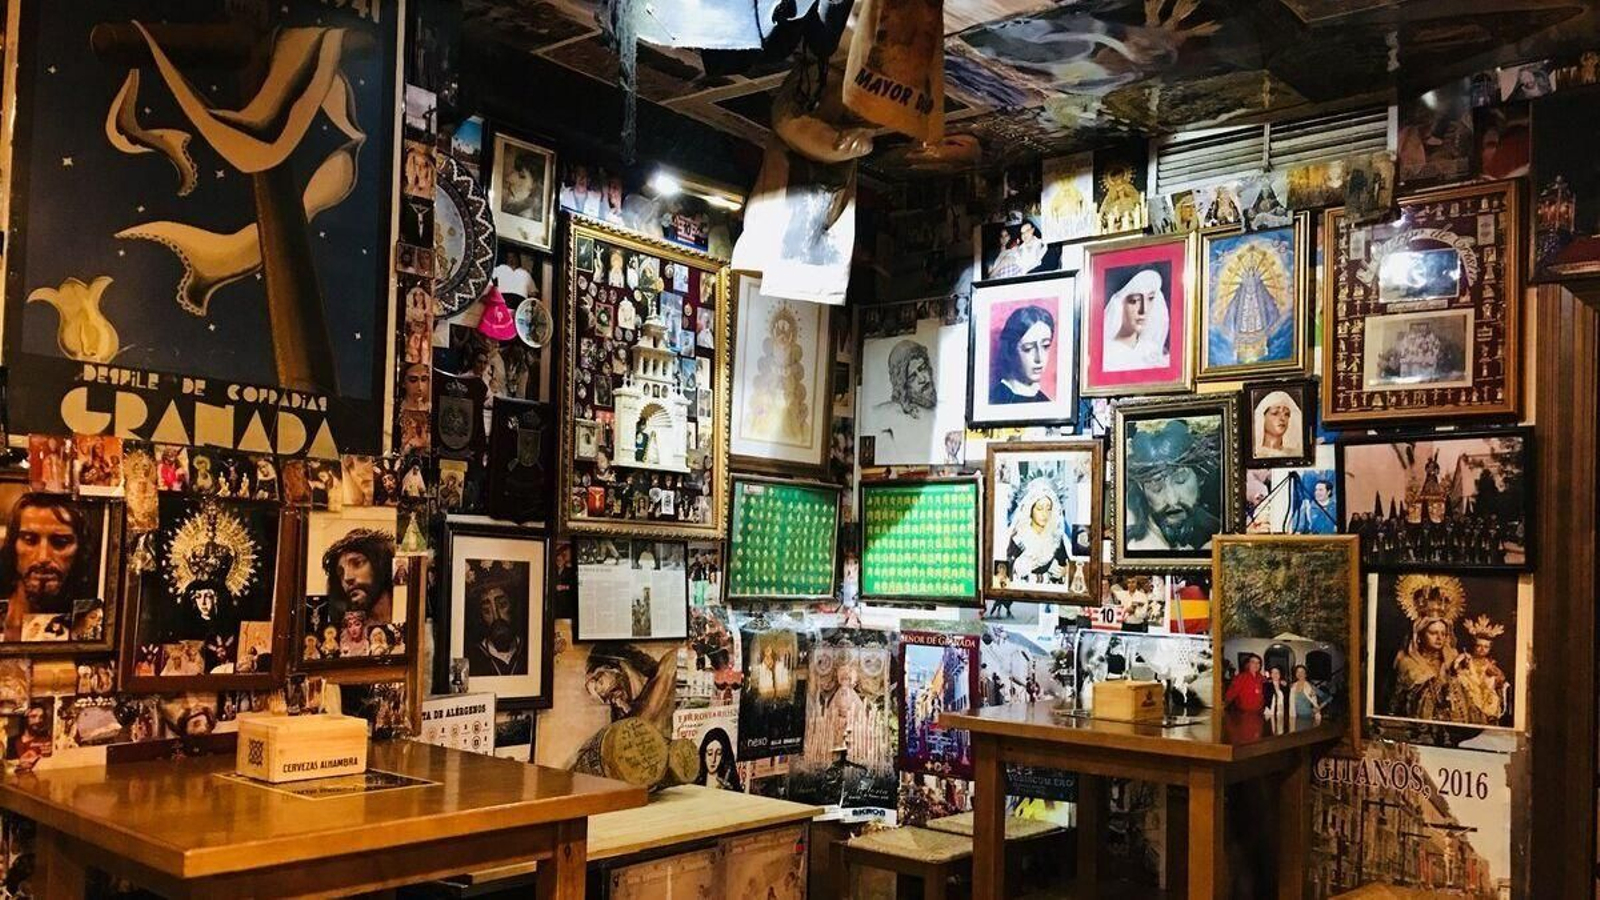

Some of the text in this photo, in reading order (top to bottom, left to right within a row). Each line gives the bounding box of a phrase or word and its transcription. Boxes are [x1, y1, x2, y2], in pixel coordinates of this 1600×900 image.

[855, 68, 913, 106] MAYOR
[83, 364, 159, 390] DESFILE
[182, 378, 205, 396] DE
[61, 387, 339, 460] GRANADA
[1100, 608, 1114, 623] 10
[927, 635, 937, 645] DE
[433, 710, 443, 719] DE
[445, 704, 486, 717] ALÉRGENOS
[283, 757, 358, 773] CERVEZAS ALHAMBRA
[1314, 757, 1489, 800] GITANOS, 2016
